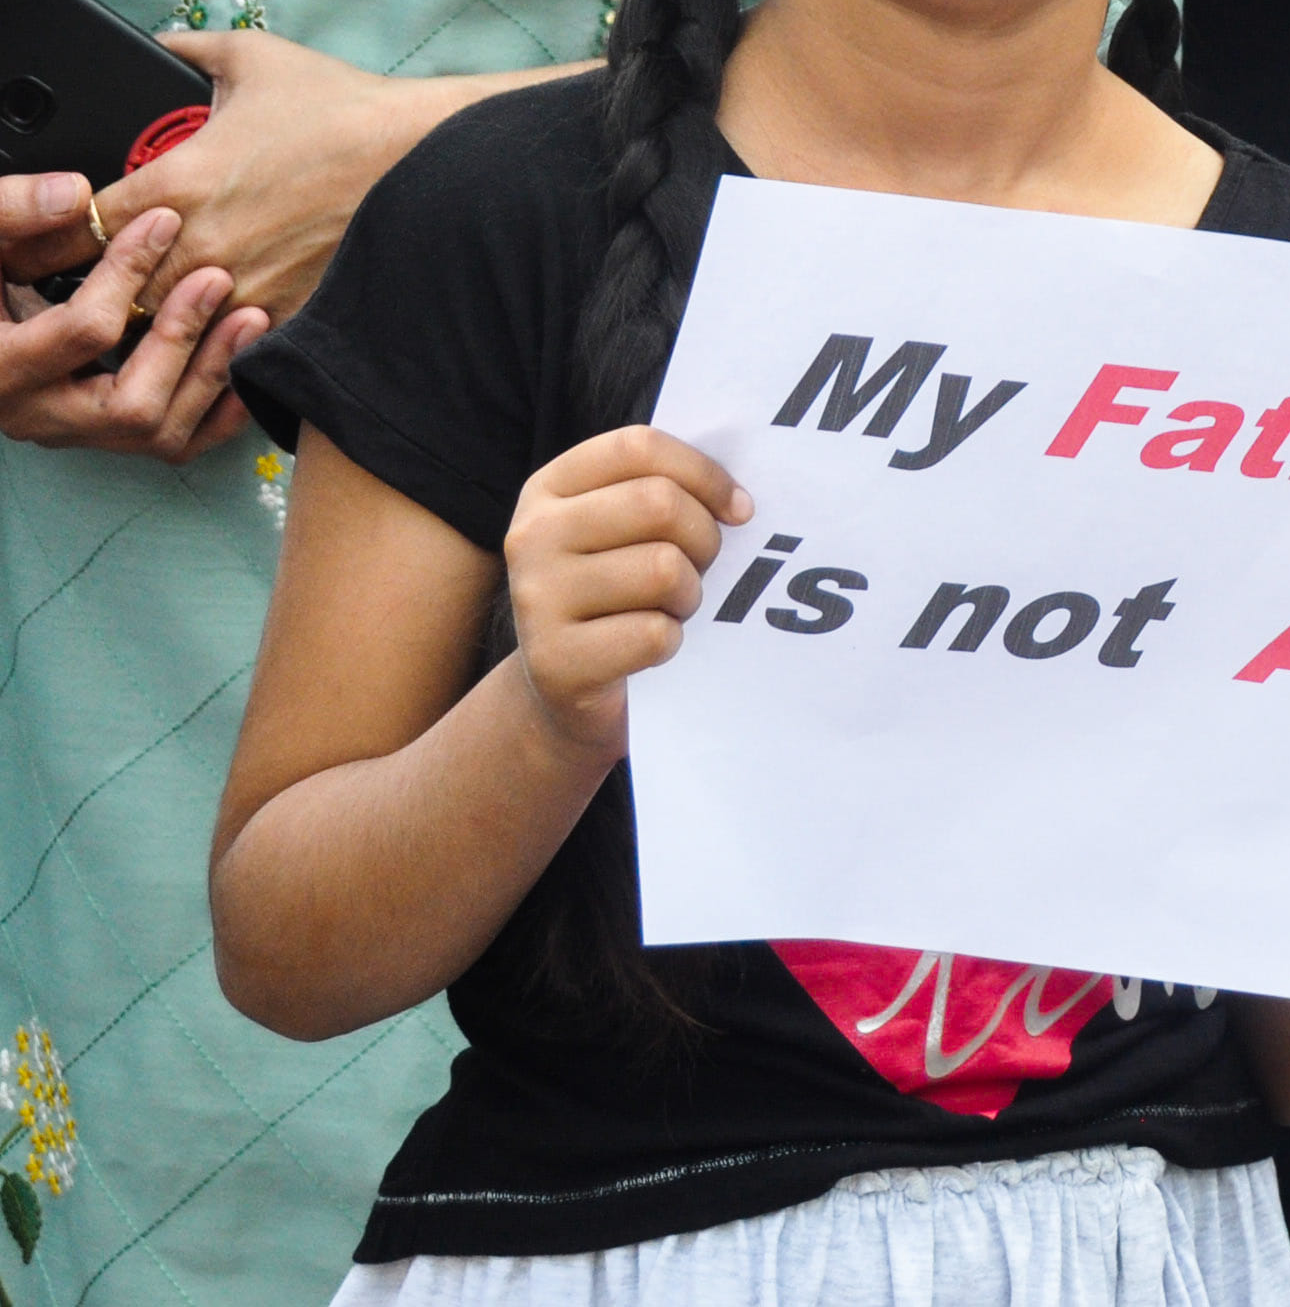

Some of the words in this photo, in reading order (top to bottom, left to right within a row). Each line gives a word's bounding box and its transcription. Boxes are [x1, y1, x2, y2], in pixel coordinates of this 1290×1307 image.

[769, 333, 1029, 472] My
[714, 534, 869, 635] is
[897, 577, 1178, 669] not
